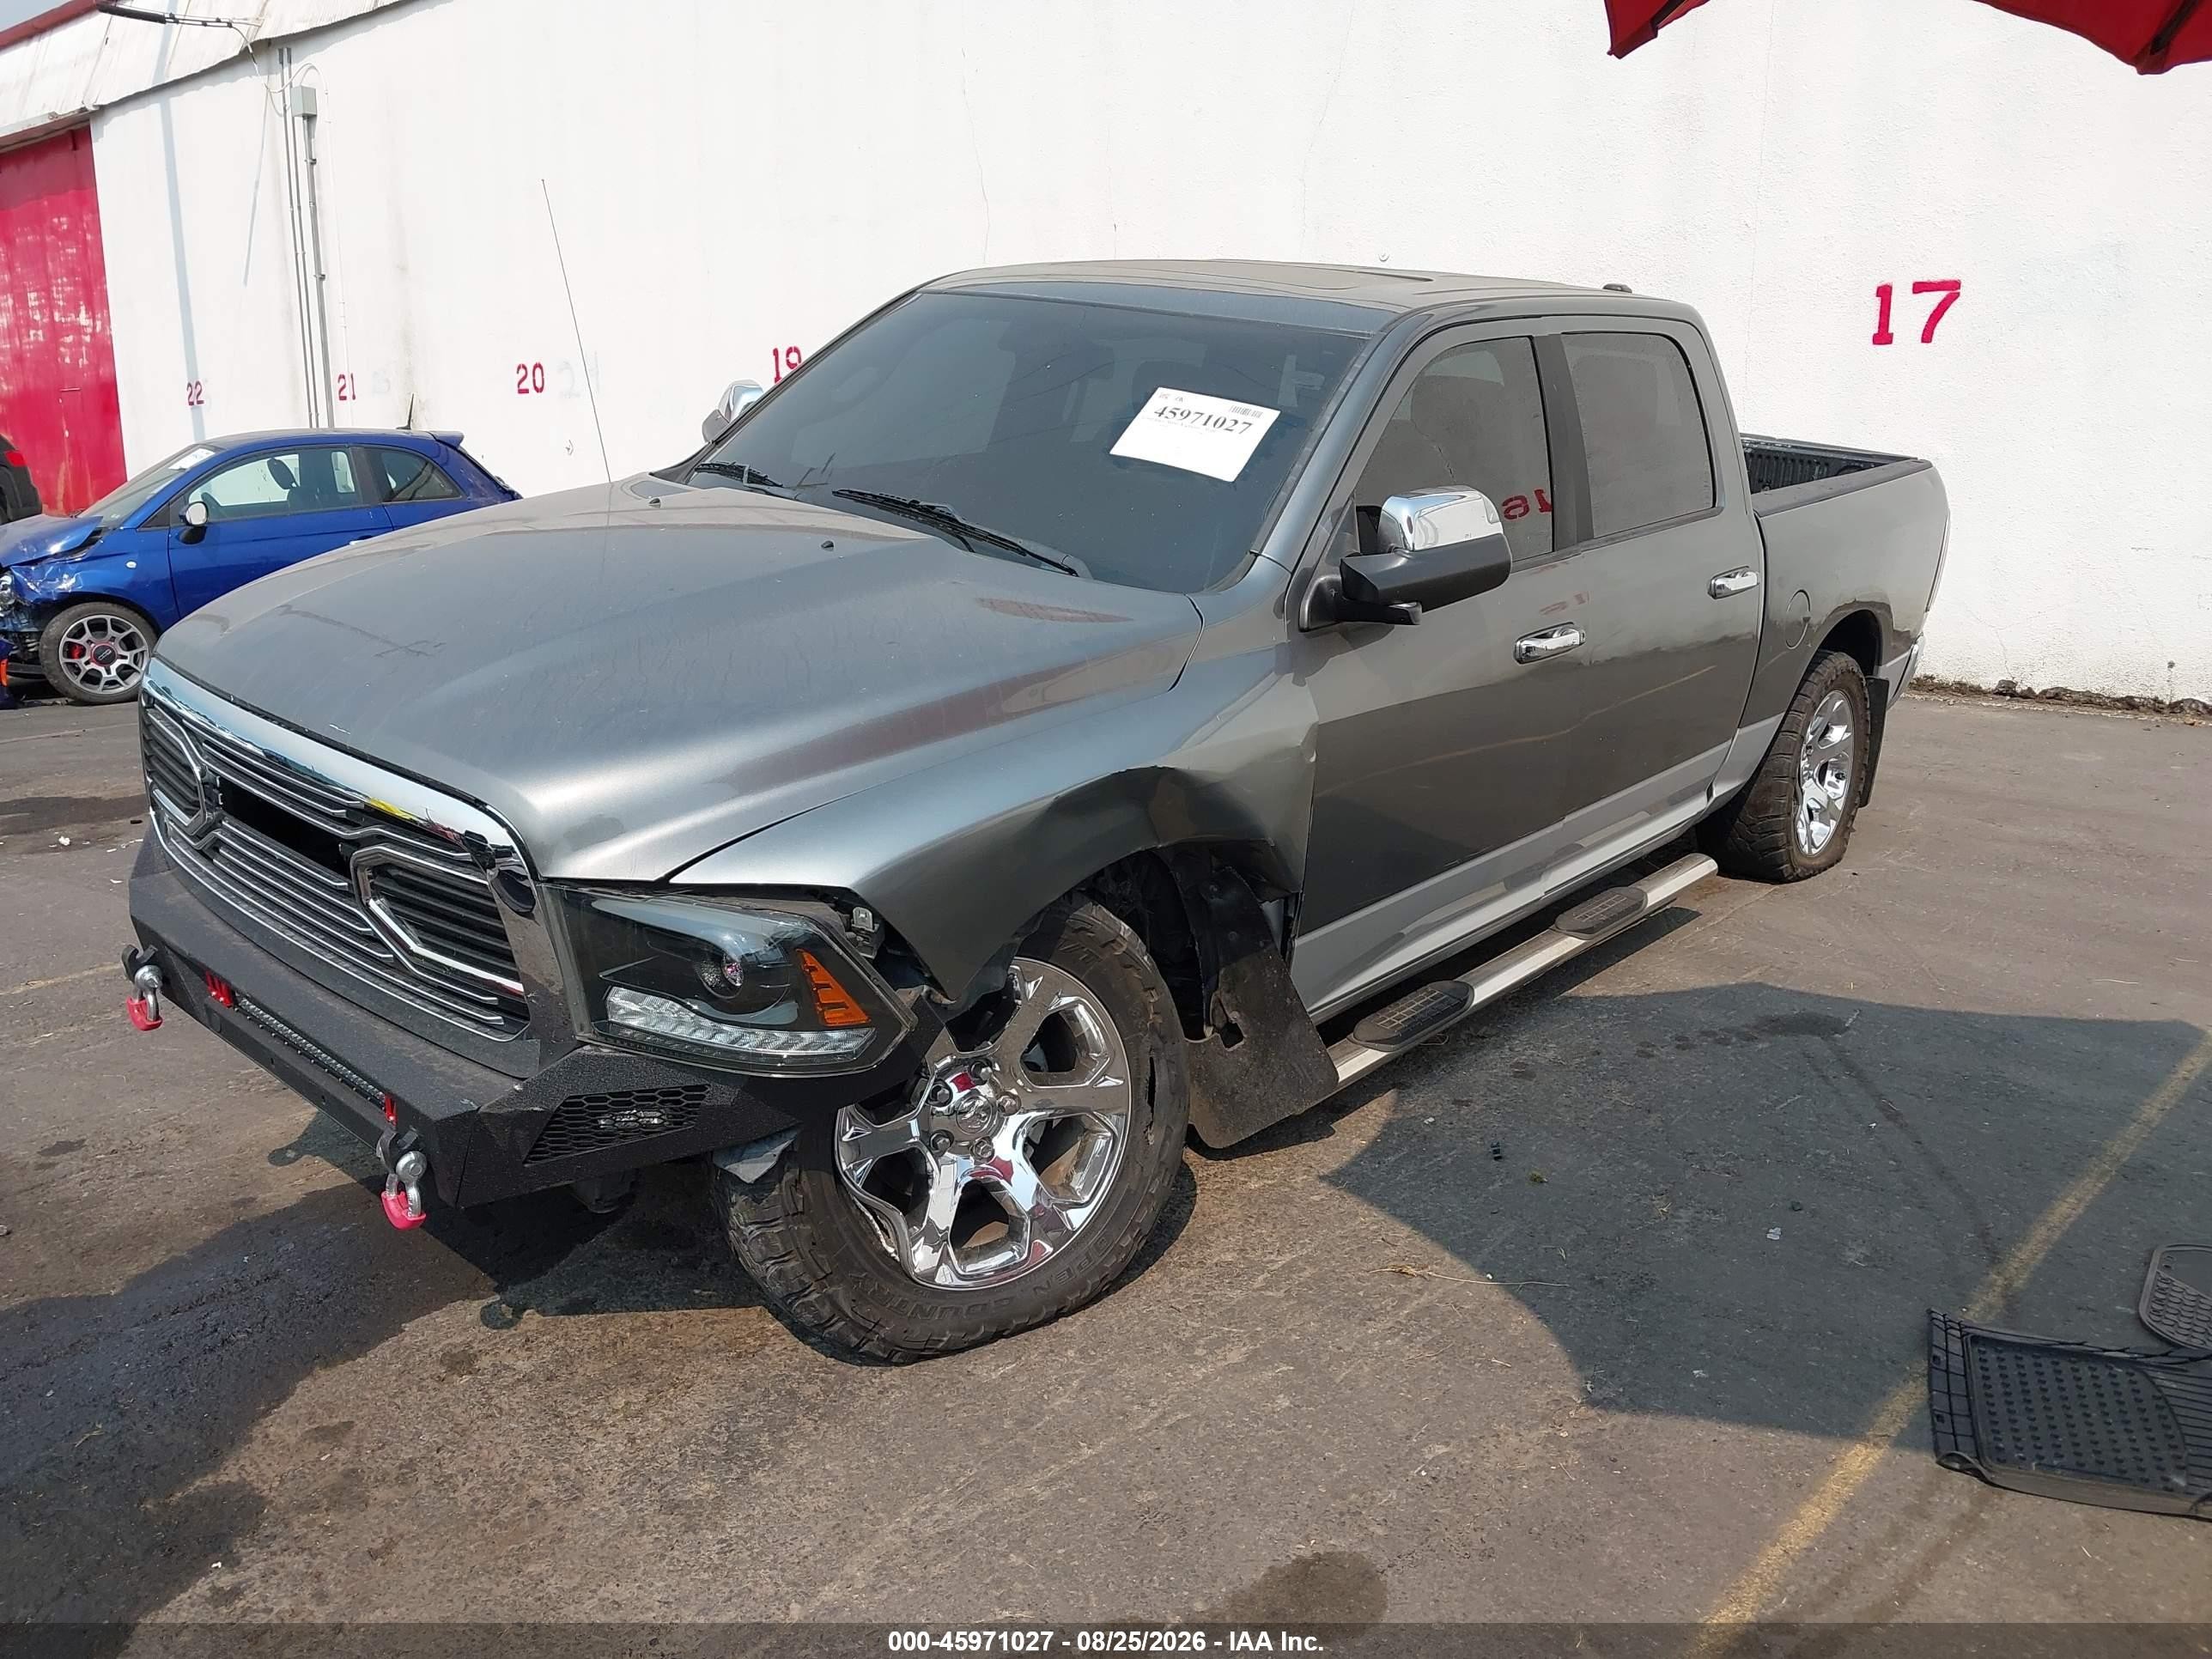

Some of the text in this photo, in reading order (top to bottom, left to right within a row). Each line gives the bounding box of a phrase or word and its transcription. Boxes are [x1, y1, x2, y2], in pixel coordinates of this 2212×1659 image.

[1872, 278, 1962, 346] 17
[516, 362, 545, 394] 20
[773, 346, 802, 384] 19
[186, 380, 205, 406] 22
[337, 373, 356, 401] 21
[1153, 406, 1253, 434] 45971027
